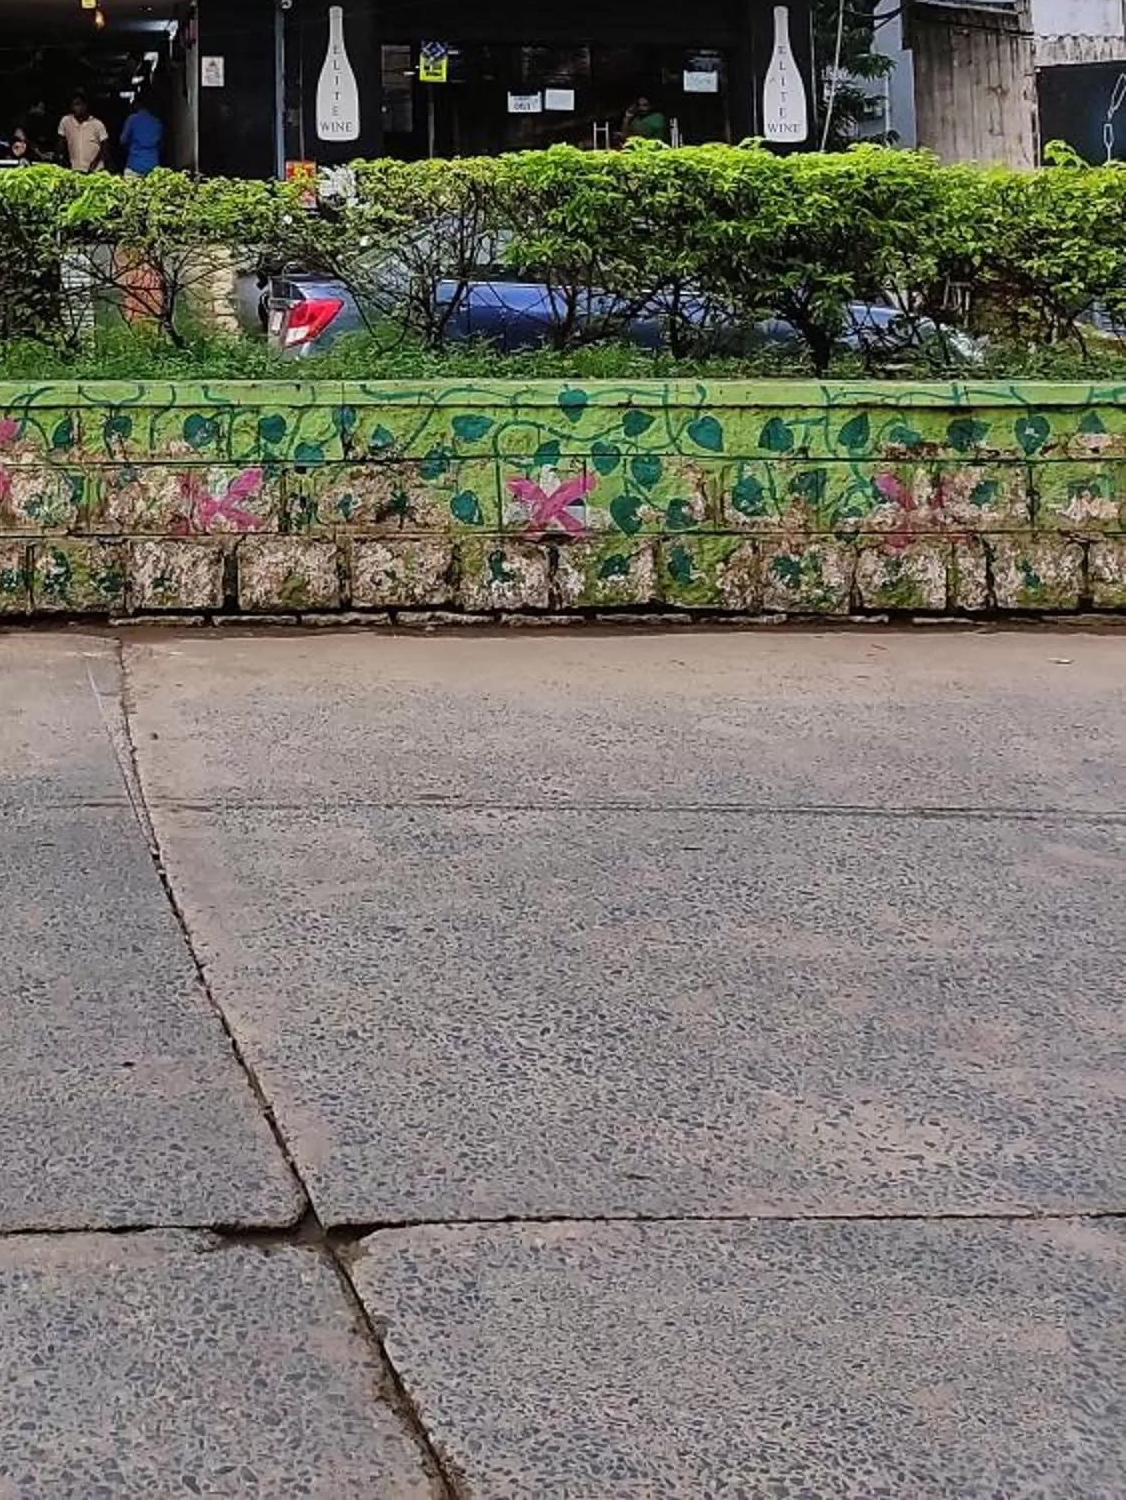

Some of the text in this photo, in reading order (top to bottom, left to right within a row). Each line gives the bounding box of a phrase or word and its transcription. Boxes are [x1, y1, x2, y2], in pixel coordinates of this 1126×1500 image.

[332, 44, 342, 117] ELITE
[777, 45, 788, 118] ELITE
[319, 121, 353, 133] WINE
[767, 123, 802, 133] WINE
